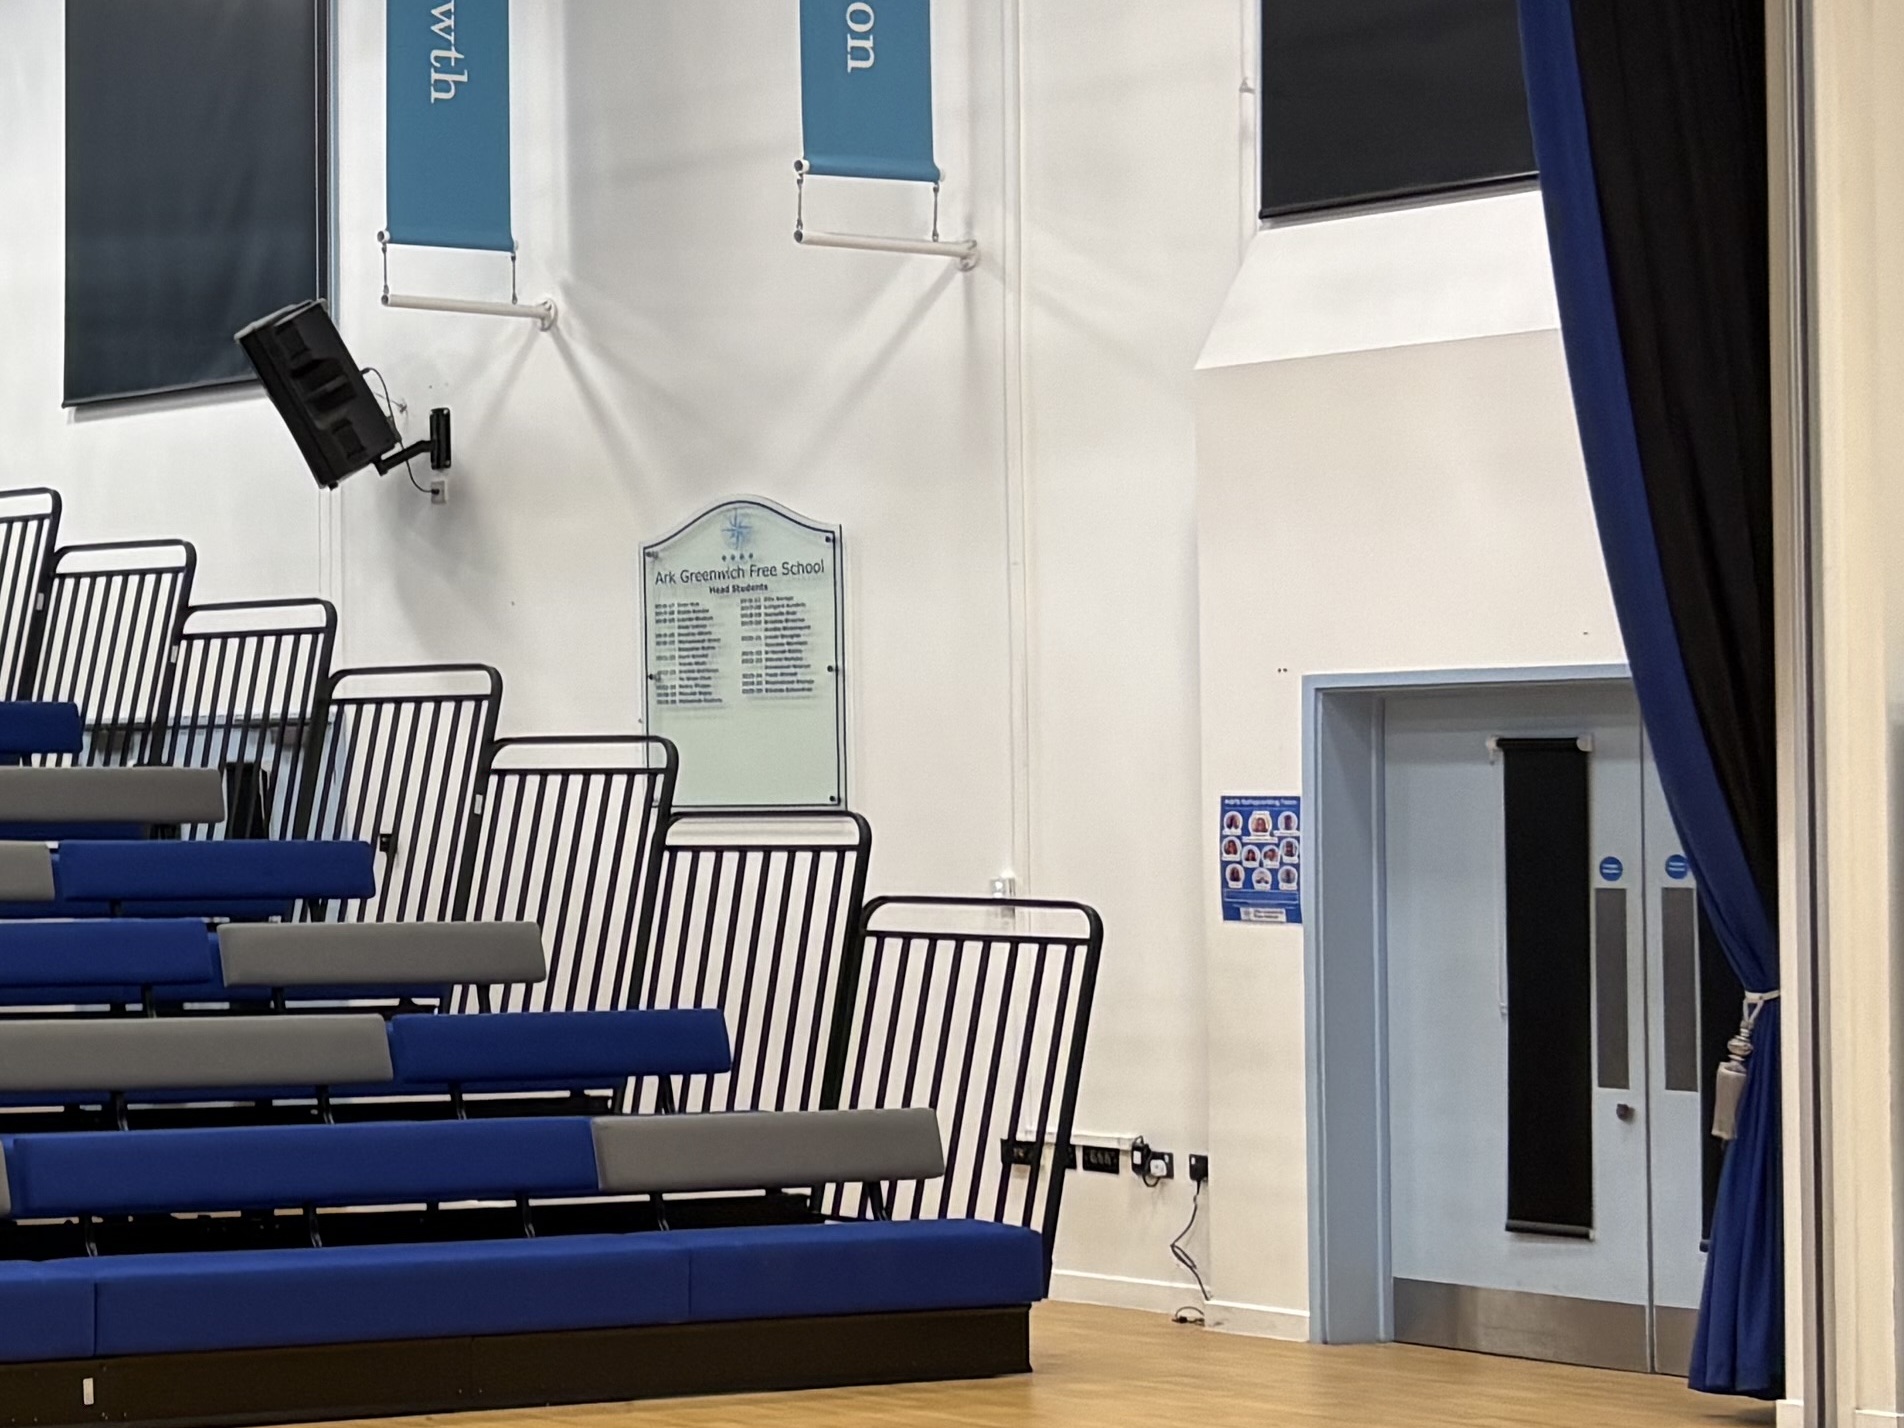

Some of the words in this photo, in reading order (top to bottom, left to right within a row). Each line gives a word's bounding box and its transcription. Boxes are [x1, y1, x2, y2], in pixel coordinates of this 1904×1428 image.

[655, 572, 677, 585] Ark
[680, 567, 745, 584] Greenwich
[749, 564, 777, 578] Free
[782, 559, 825, 576] School
[709, 585, 730, 594] Head
[732, 582, 768, 593] Students
